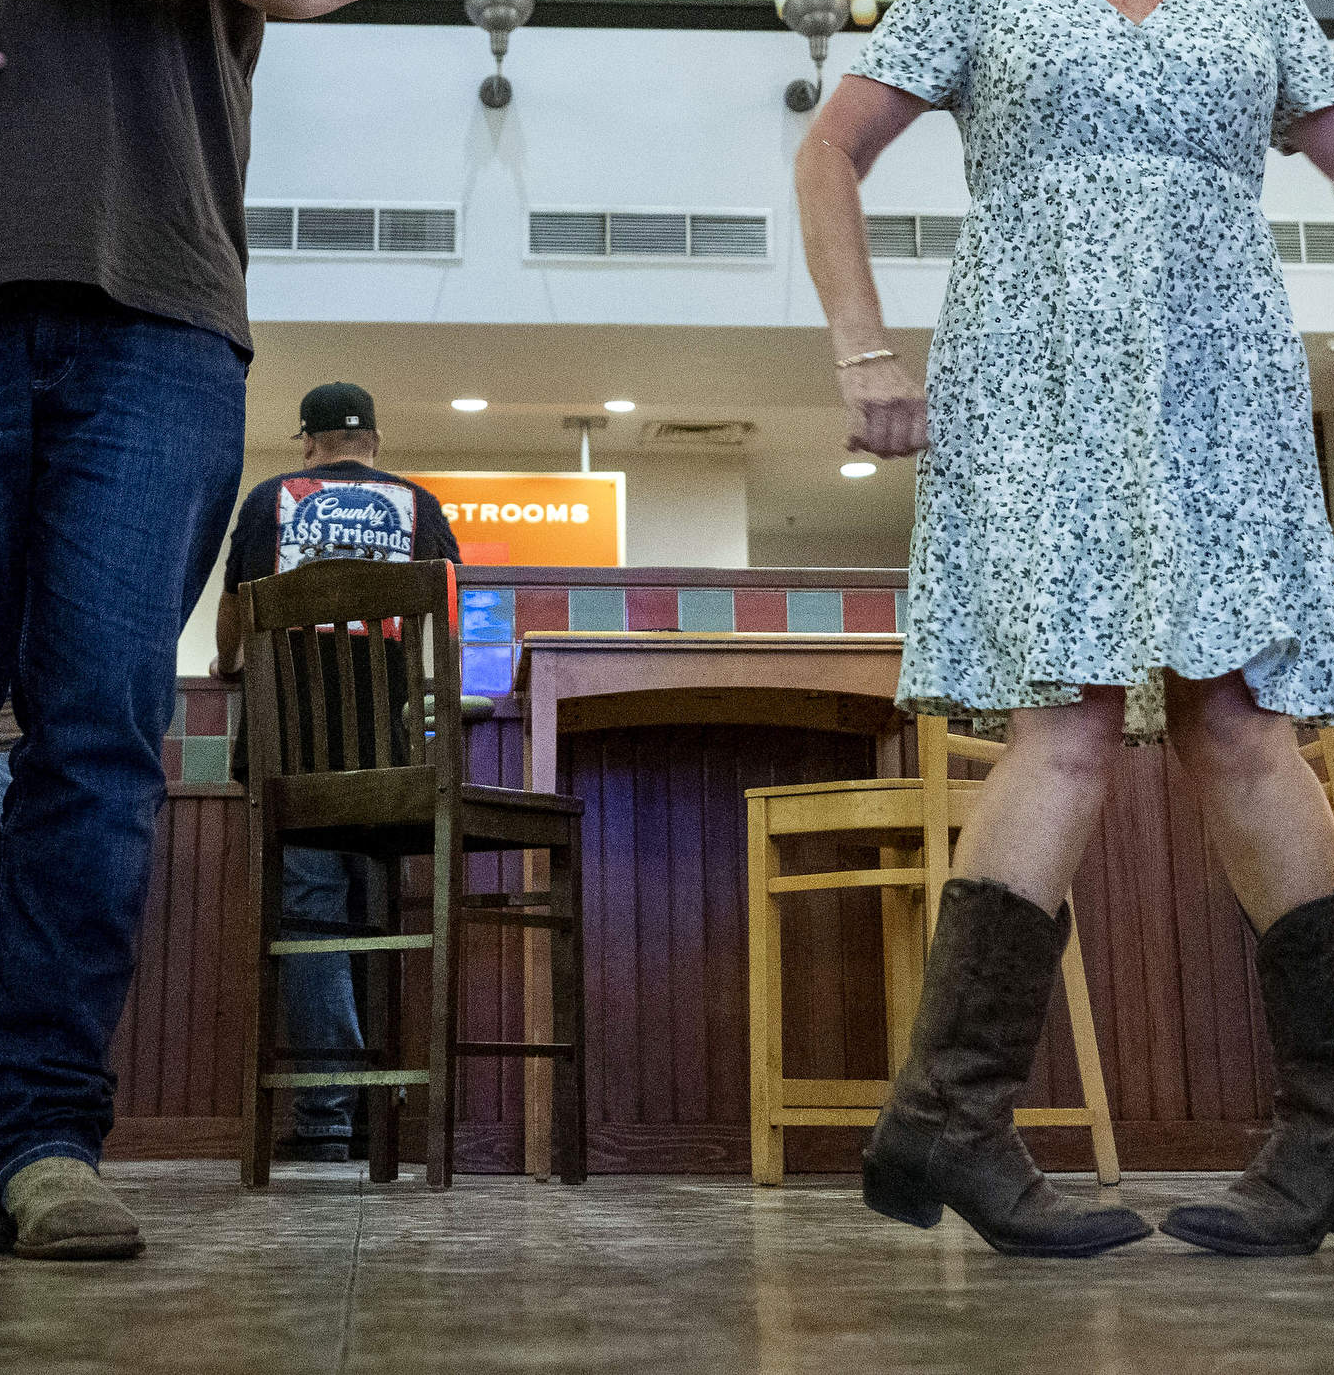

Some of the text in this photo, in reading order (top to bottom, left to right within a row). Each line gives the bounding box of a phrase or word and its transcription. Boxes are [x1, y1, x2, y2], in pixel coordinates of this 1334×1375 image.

[314, 497, 388, 527] Country
[441, 502, 590, 524] STROOMS
[328, 522, 412, 553] Friends
